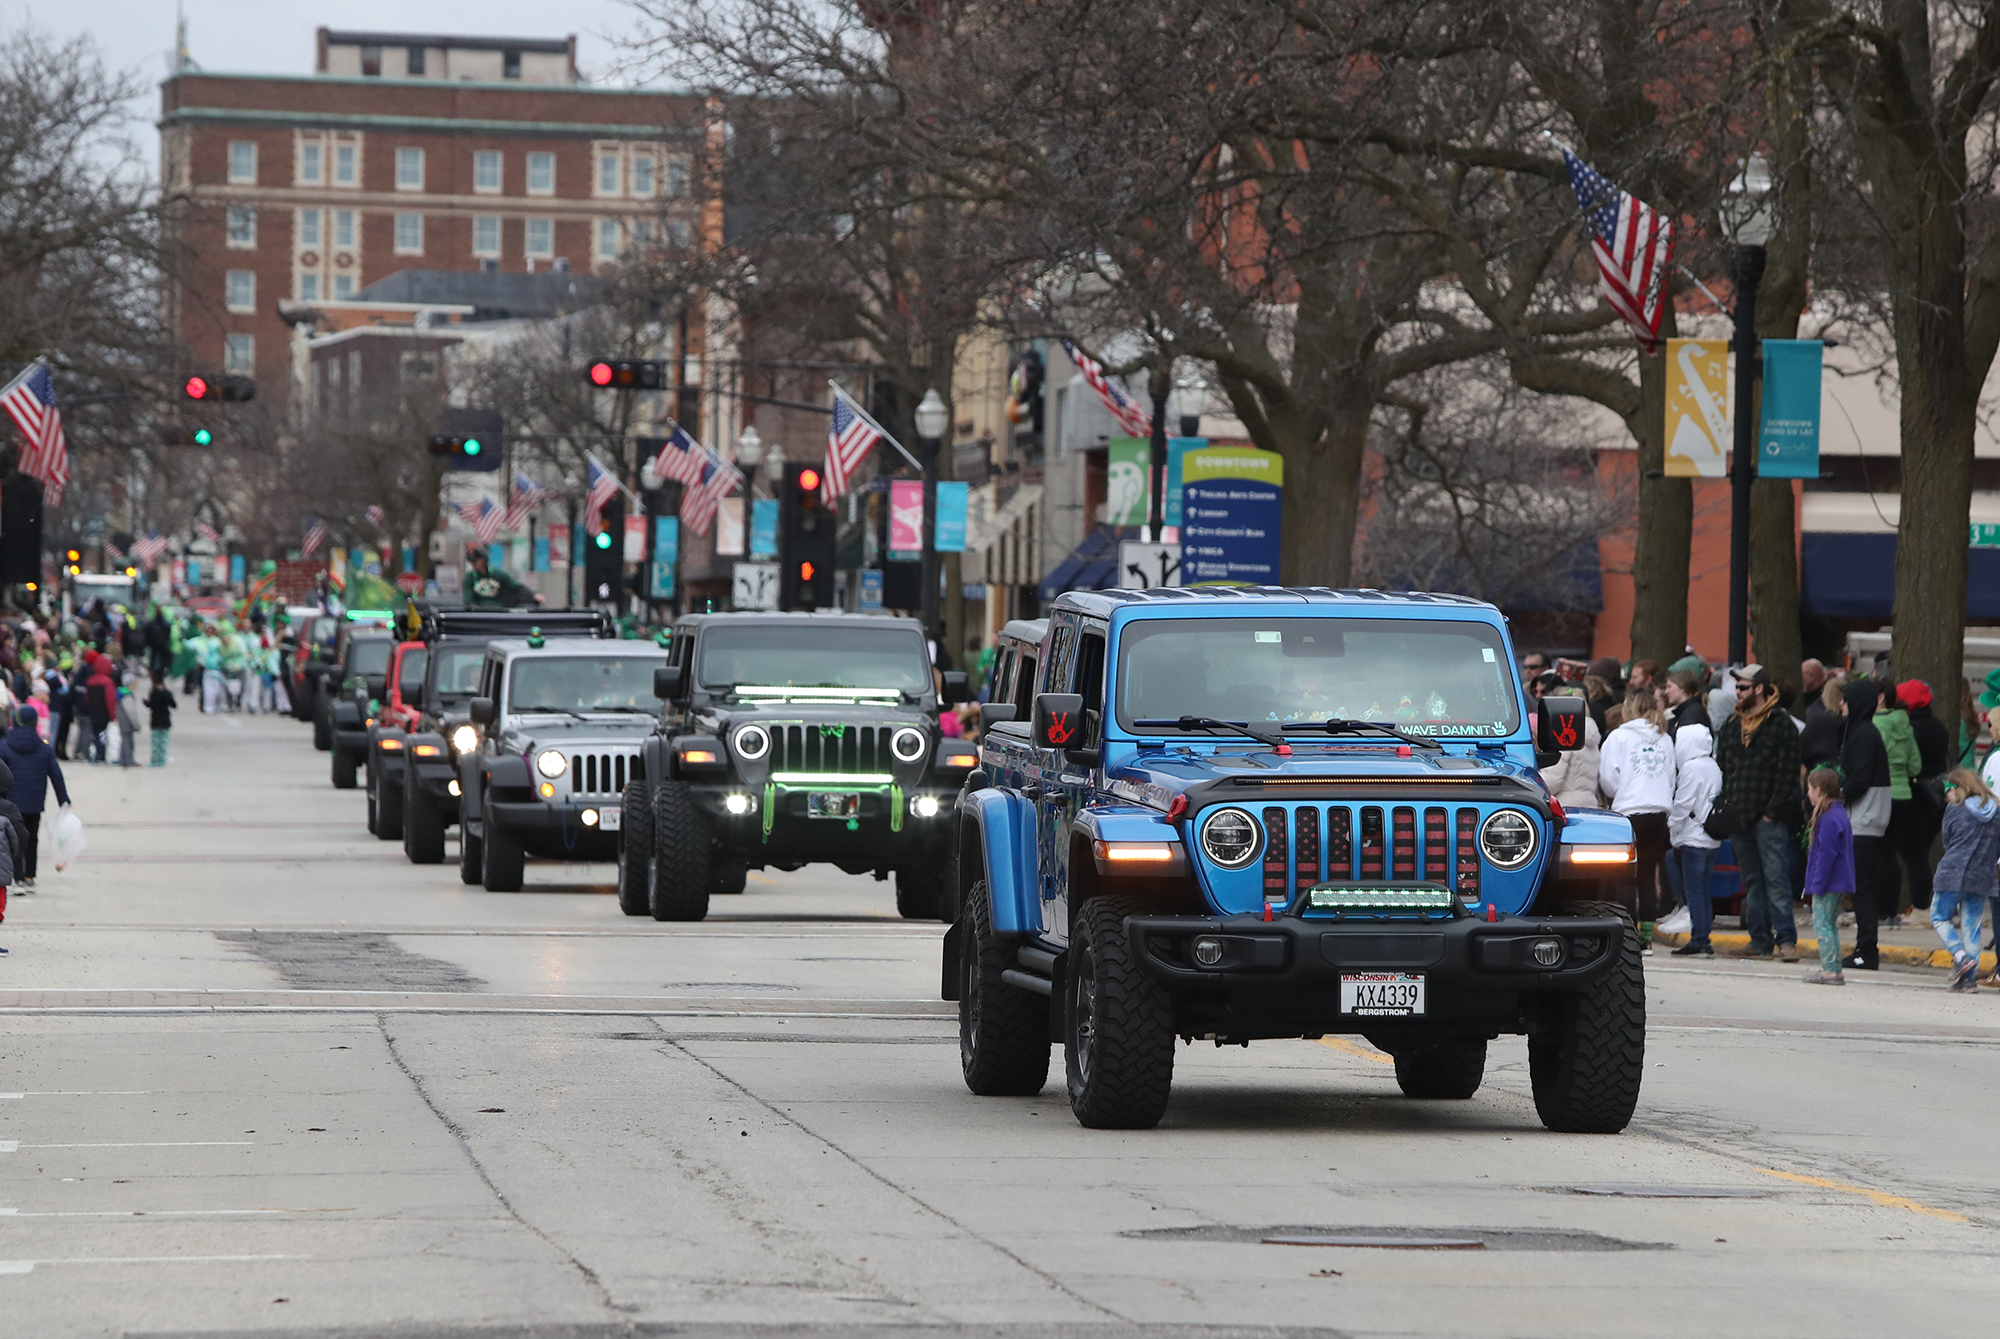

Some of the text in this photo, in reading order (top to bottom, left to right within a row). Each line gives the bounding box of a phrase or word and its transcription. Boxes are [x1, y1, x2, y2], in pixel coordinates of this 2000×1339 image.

[1766, 419, 1813, 427] DOWNTOWN
[1799, 428, 1815, 436] LAC
[1196, 456, 1269, 468] DOWNTOWN
[1400, 725, 1491, 735] WAVE DAMNIT
[1119, 775, 1178, 805] RUBICON
[1357, 985, 1418, 1006] KX4339
[1358, 1008, 1408, 1016] BERGSTROM
